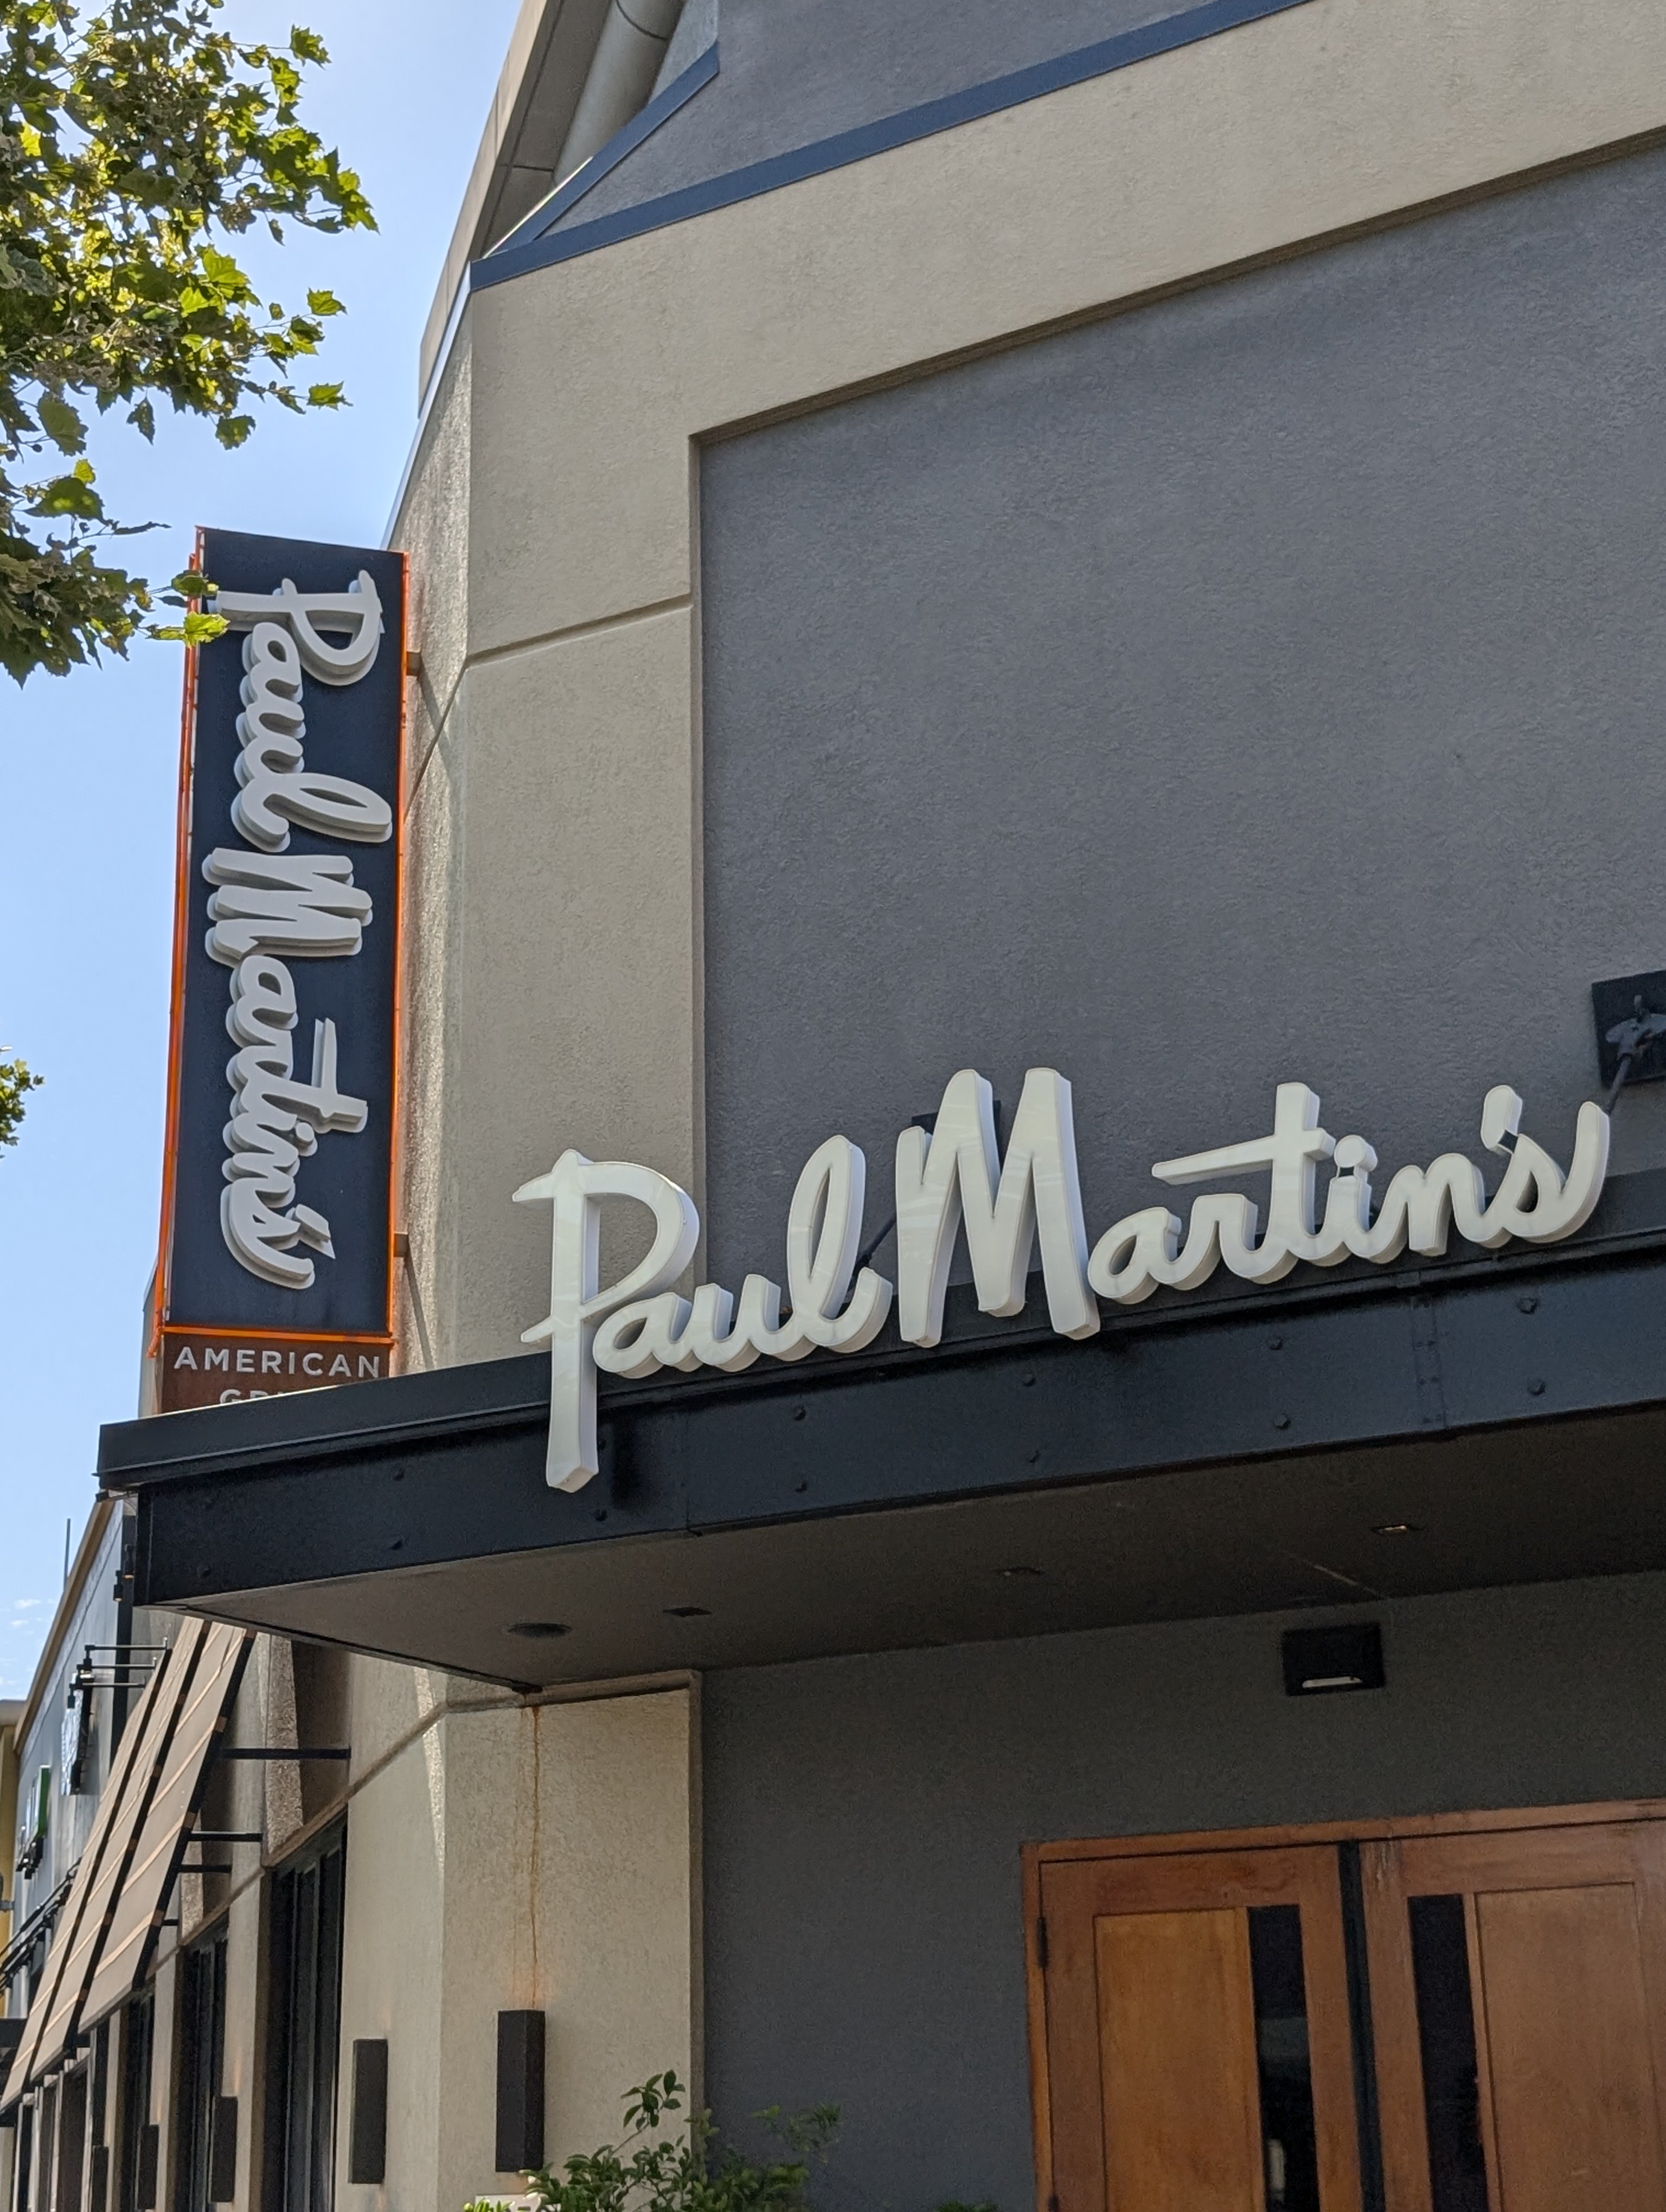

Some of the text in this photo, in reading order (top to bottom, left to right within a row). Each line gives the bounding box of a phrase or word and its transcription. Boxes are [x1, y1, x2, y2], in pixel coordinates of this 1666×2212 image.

[201, 569, 393, 1290] Paul Martin's
[174, 1346, 380, 1379] AMERICAN
[512, 1068, 1611, 1494] Paul Martin's
